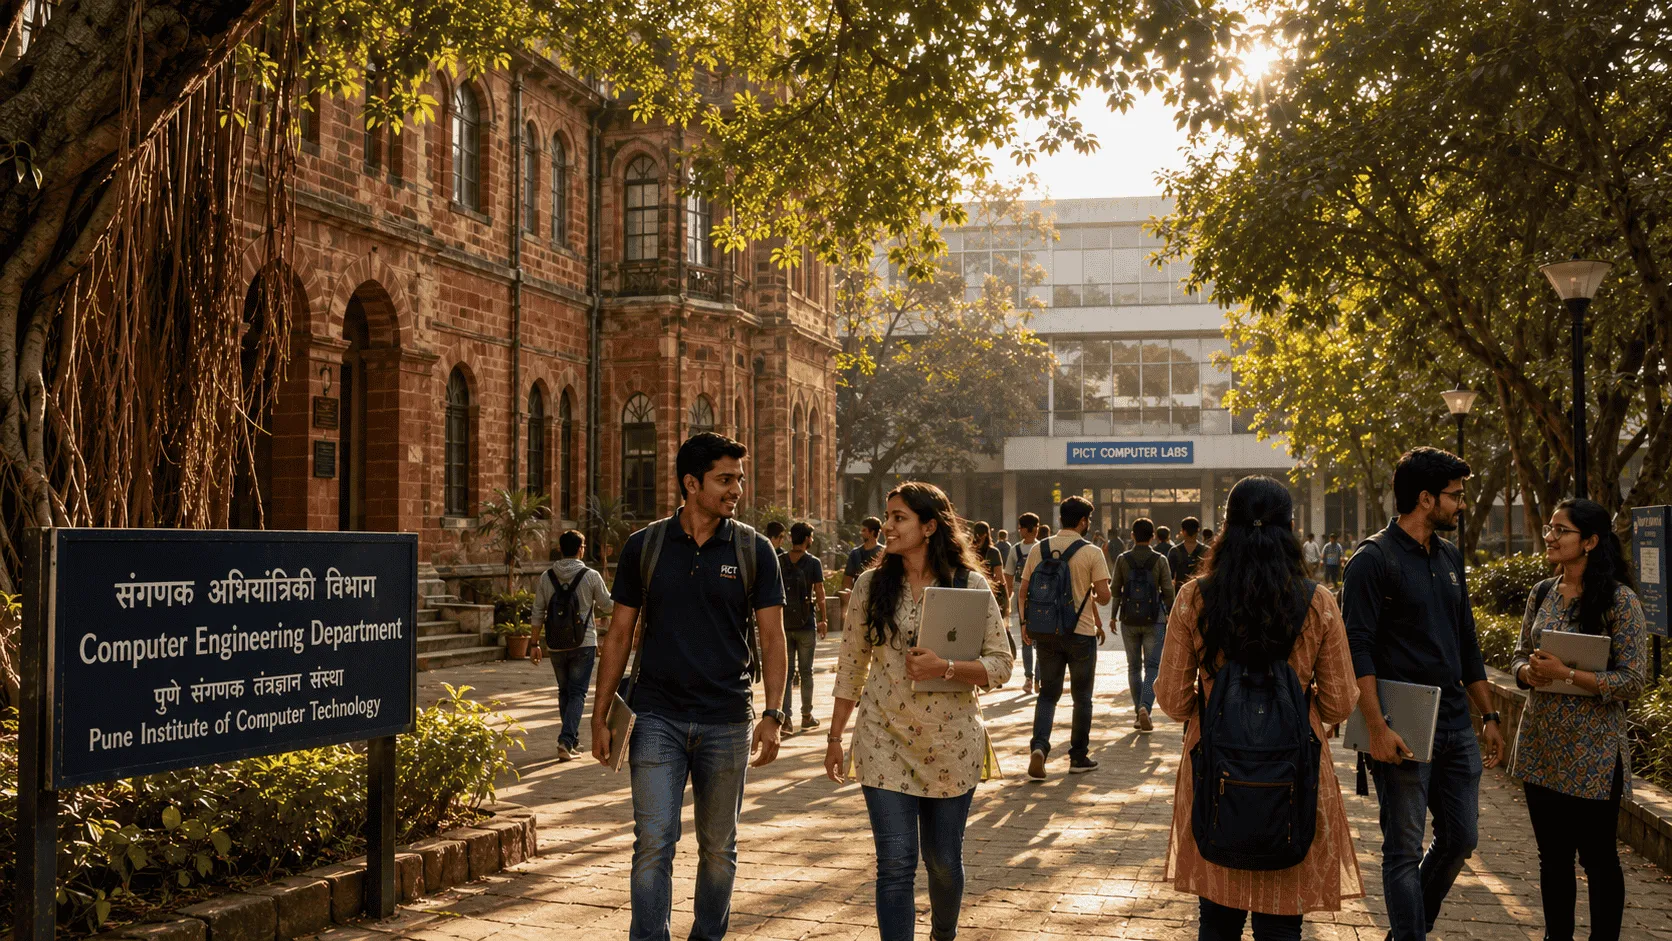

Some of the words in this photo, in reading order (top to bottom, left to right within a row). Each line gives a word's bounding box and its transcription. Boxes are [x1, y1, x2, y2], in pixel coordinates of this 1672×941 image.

[1072, 447, 1097, 459] PICT
[1099, 447, 1158, 459] COMPUTER
[1161, 446, 1188, 458] LABS
[114, 572, 195, 609] संगणक
[207, 567, 317, 604] अभियांत्रिकी
[325, 566, 377, 600] विभाग
[79, 632, 189, 669] Computer
[195, 625, 305, 661] Engineering
[311, 617, 403, 651] Department
[153, 678, 182, 715] पुणे
[190, 677, 245, 704] संगणक
[252, 670, 302, 697] तंत्रज्ञान
[309, 665, 345, 690] संस्था
[89, 727, 133, 752] Pune
[140, 718, 209, 746] Institute
[214, 713, 231, 735] of
[236, 707, 306, 733] Computer
[309, 695, 381, 722] Technology
